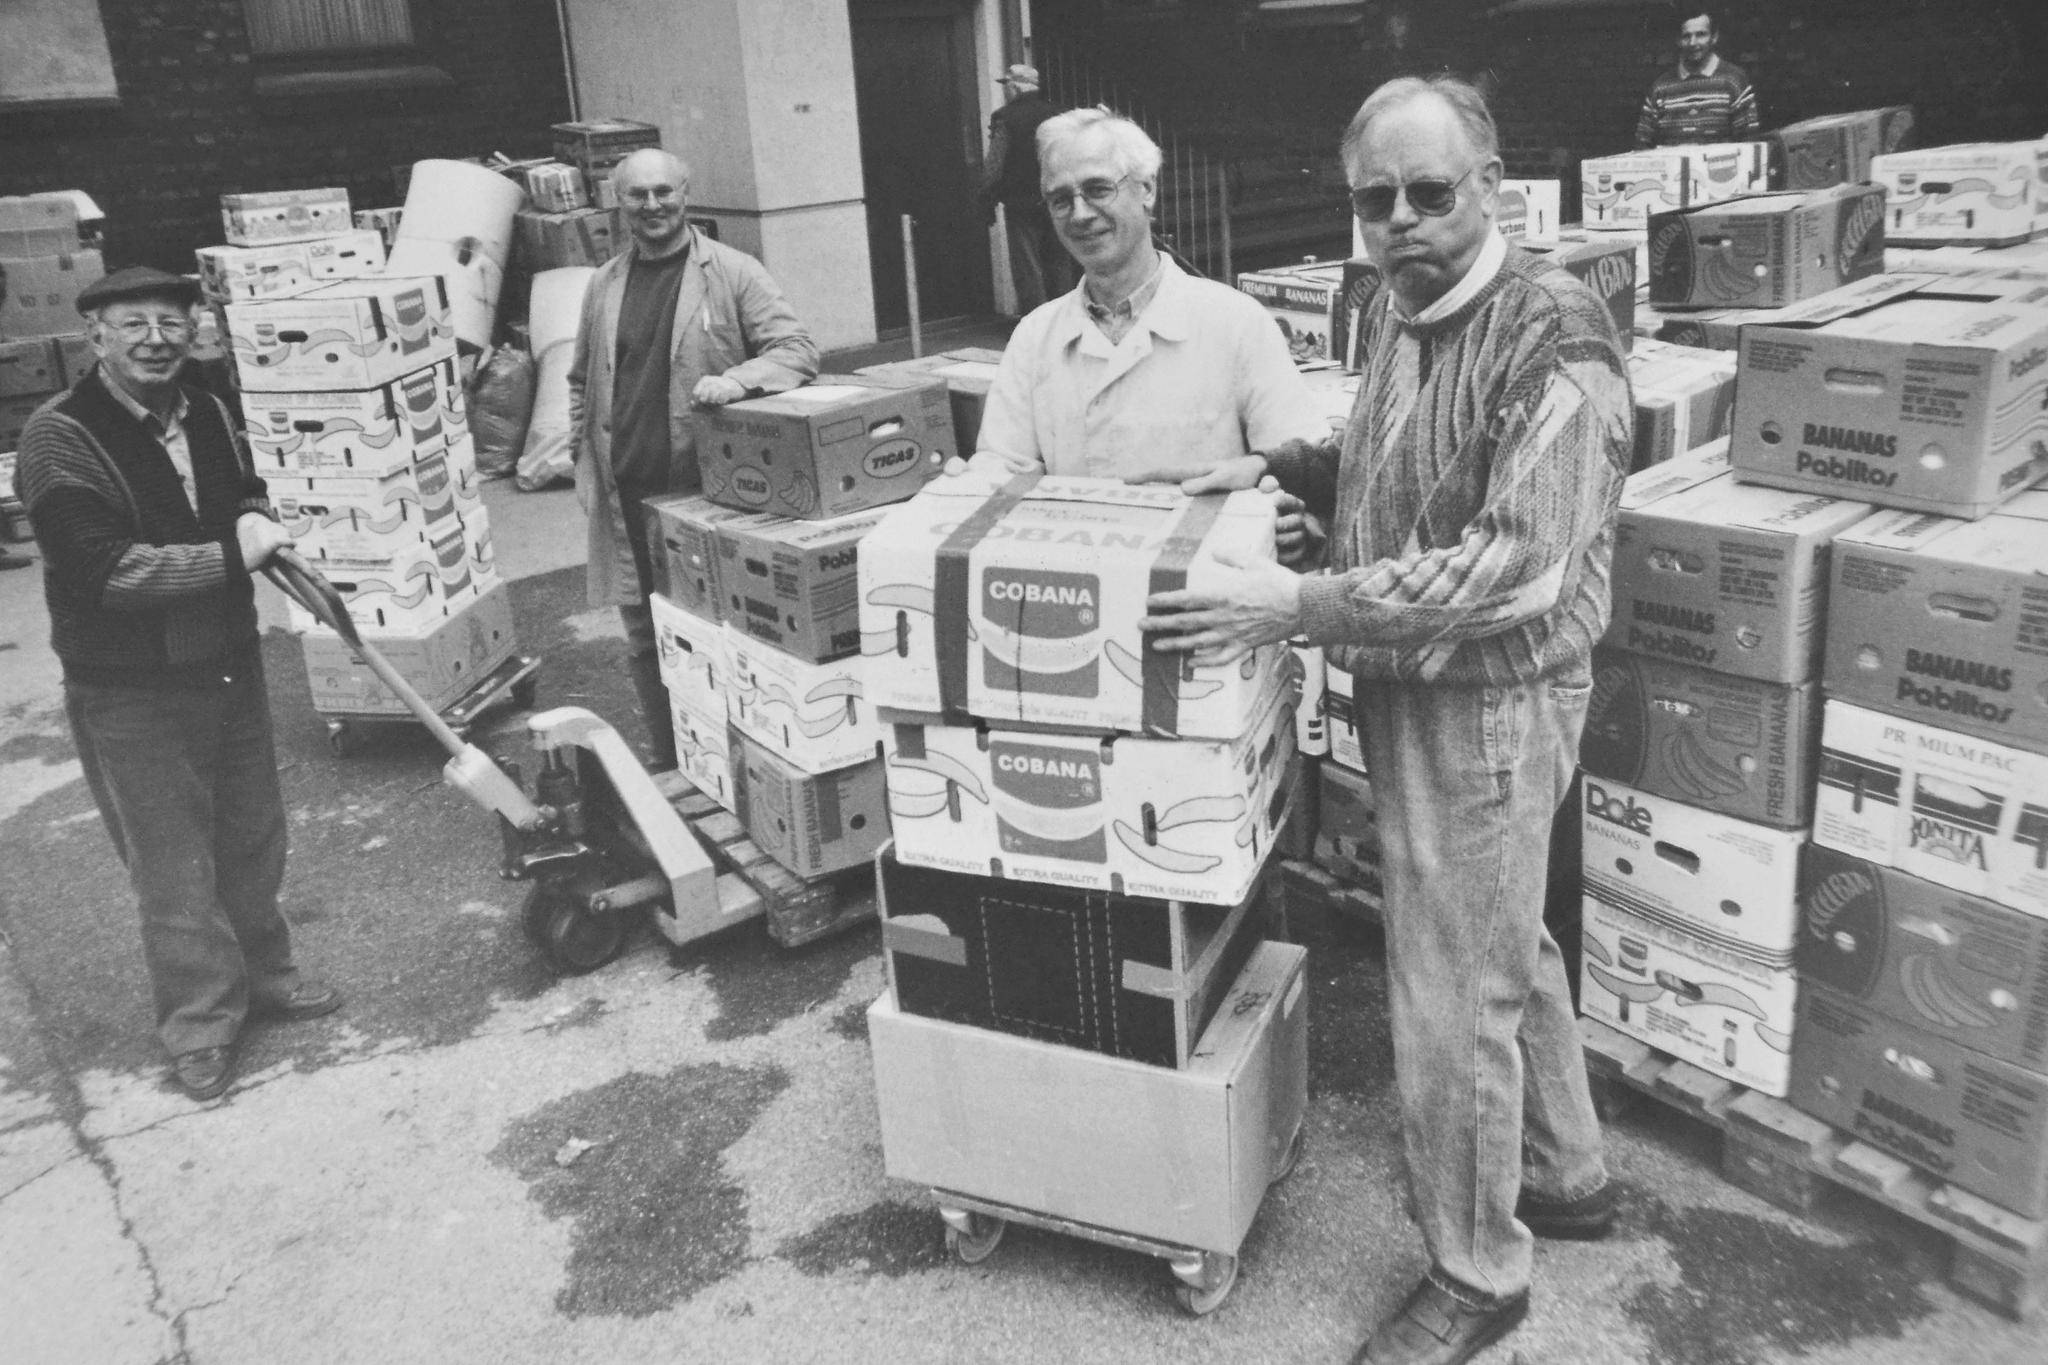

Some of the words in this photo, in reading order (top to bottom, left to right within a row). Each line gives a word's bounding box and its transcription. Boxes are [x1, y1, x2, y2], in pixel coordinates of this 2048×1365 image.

[1241, 281, 1278, 297] PREMIUM
[1285, 288, 1328, 306] BANANAS
[1802, 422, 1898, 458] BANANAS
[870, 447, 915, 471] TICAS
[989, 579, 1095, 608] COBANA
[1631, 599, 1716, 635] BANANAS
[1905, 648, 2013, 693] BANANAS
[1768, 690, 1788, 766] BANANAS
[1883, 725, 1978, 763] PRMIUM
[998, 754, 1093, 780] COBANA
[1585, 783, 1653, 837] Dole
[1766, 769, 1786, 818] FRESH
[1584, 820, 1641, 851] BANANAS
[1050, 872, 1099, 885] QUALITY
